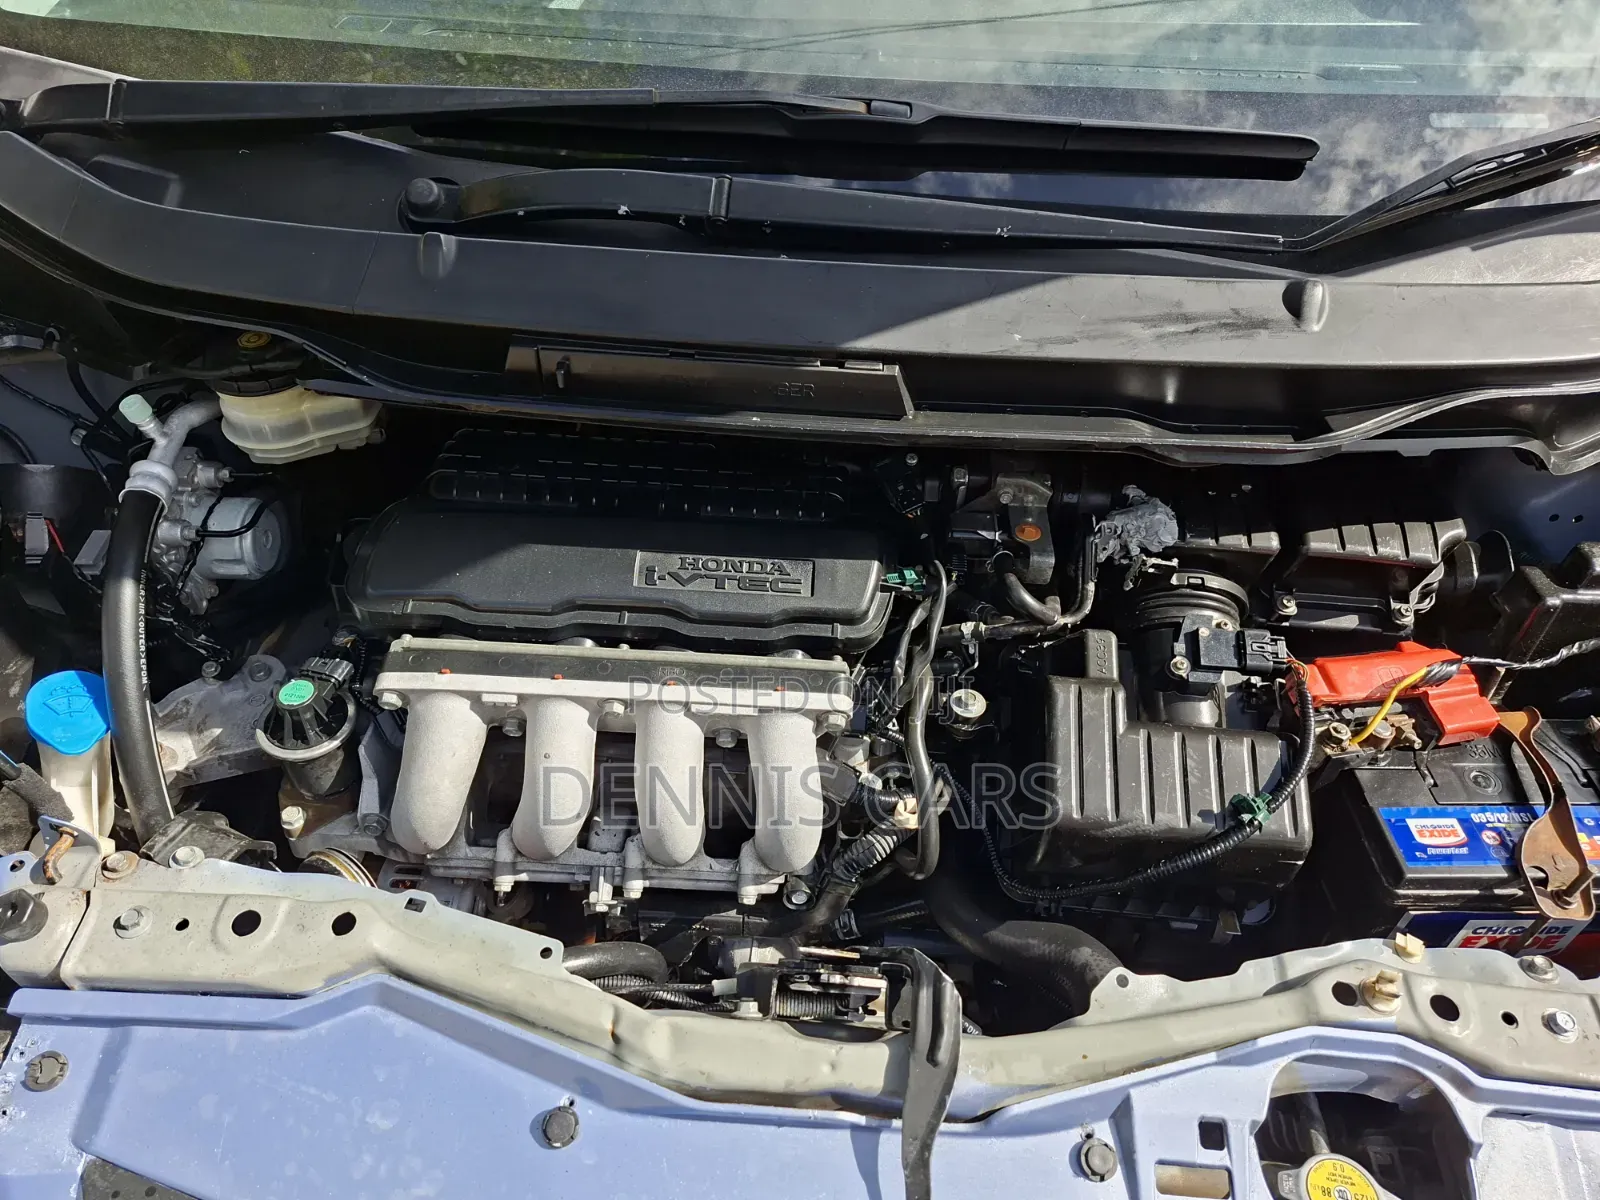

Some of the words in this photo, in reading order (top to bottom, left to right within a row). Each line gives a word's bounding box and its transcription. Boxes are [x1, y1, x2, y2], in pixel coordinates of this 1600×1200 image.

[678, 556, 791, 576] HONDA
[645, 565, 803, 594] i-VTEC
[1416, 829, 1461, 838] EXIDE
[1471, 926, 1573, 935] CHLOIDE
